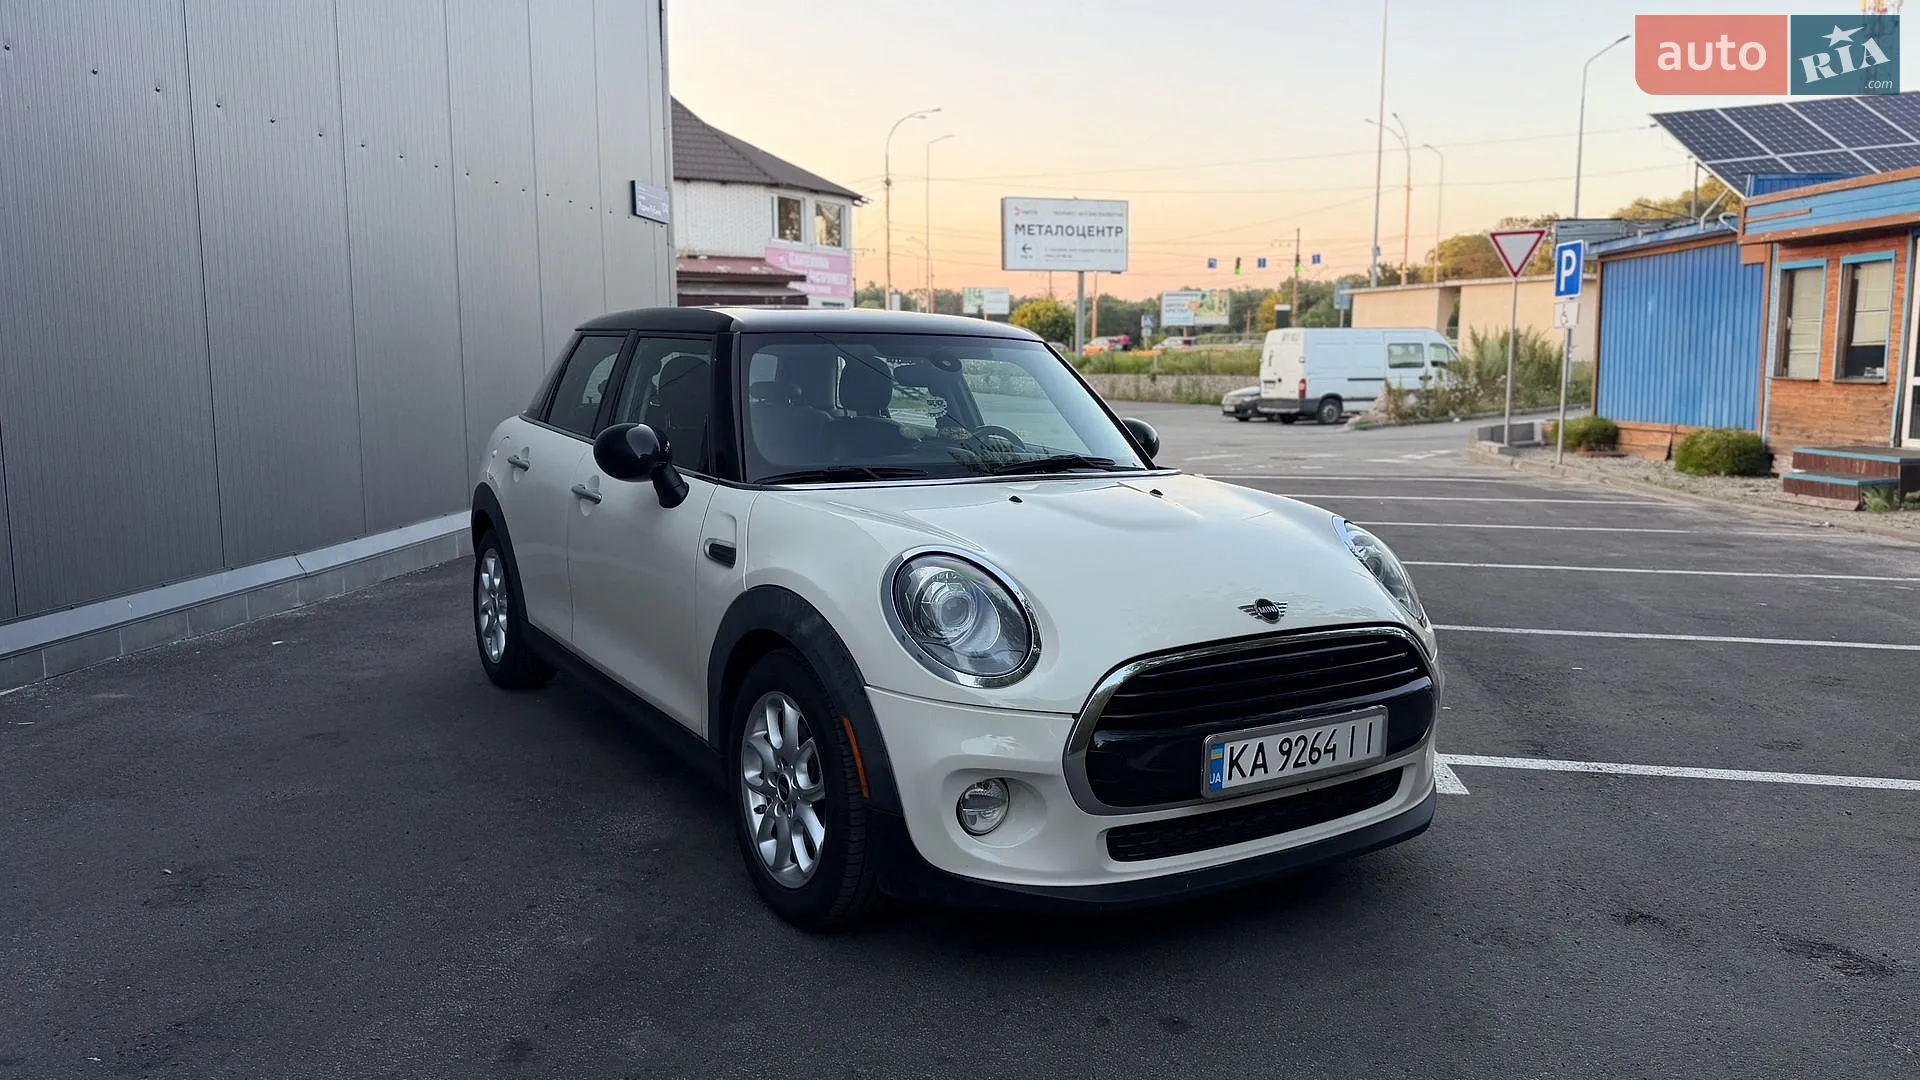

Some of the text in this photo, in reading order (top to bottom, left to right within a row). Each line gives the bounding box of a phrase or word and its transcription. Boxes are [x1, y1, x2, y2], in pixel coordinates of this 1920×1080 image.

[1014, 223, 1124, 240] МЕТАЛОЦЕНТР
[1559, 249, 1577, 292] P
[1257, 605, 1278, 614] MINI
[1227, 741, 1269, 781] KA
[1278, 728, 1337, 772] 9264
[1209, 772, 1222, 785] UA
